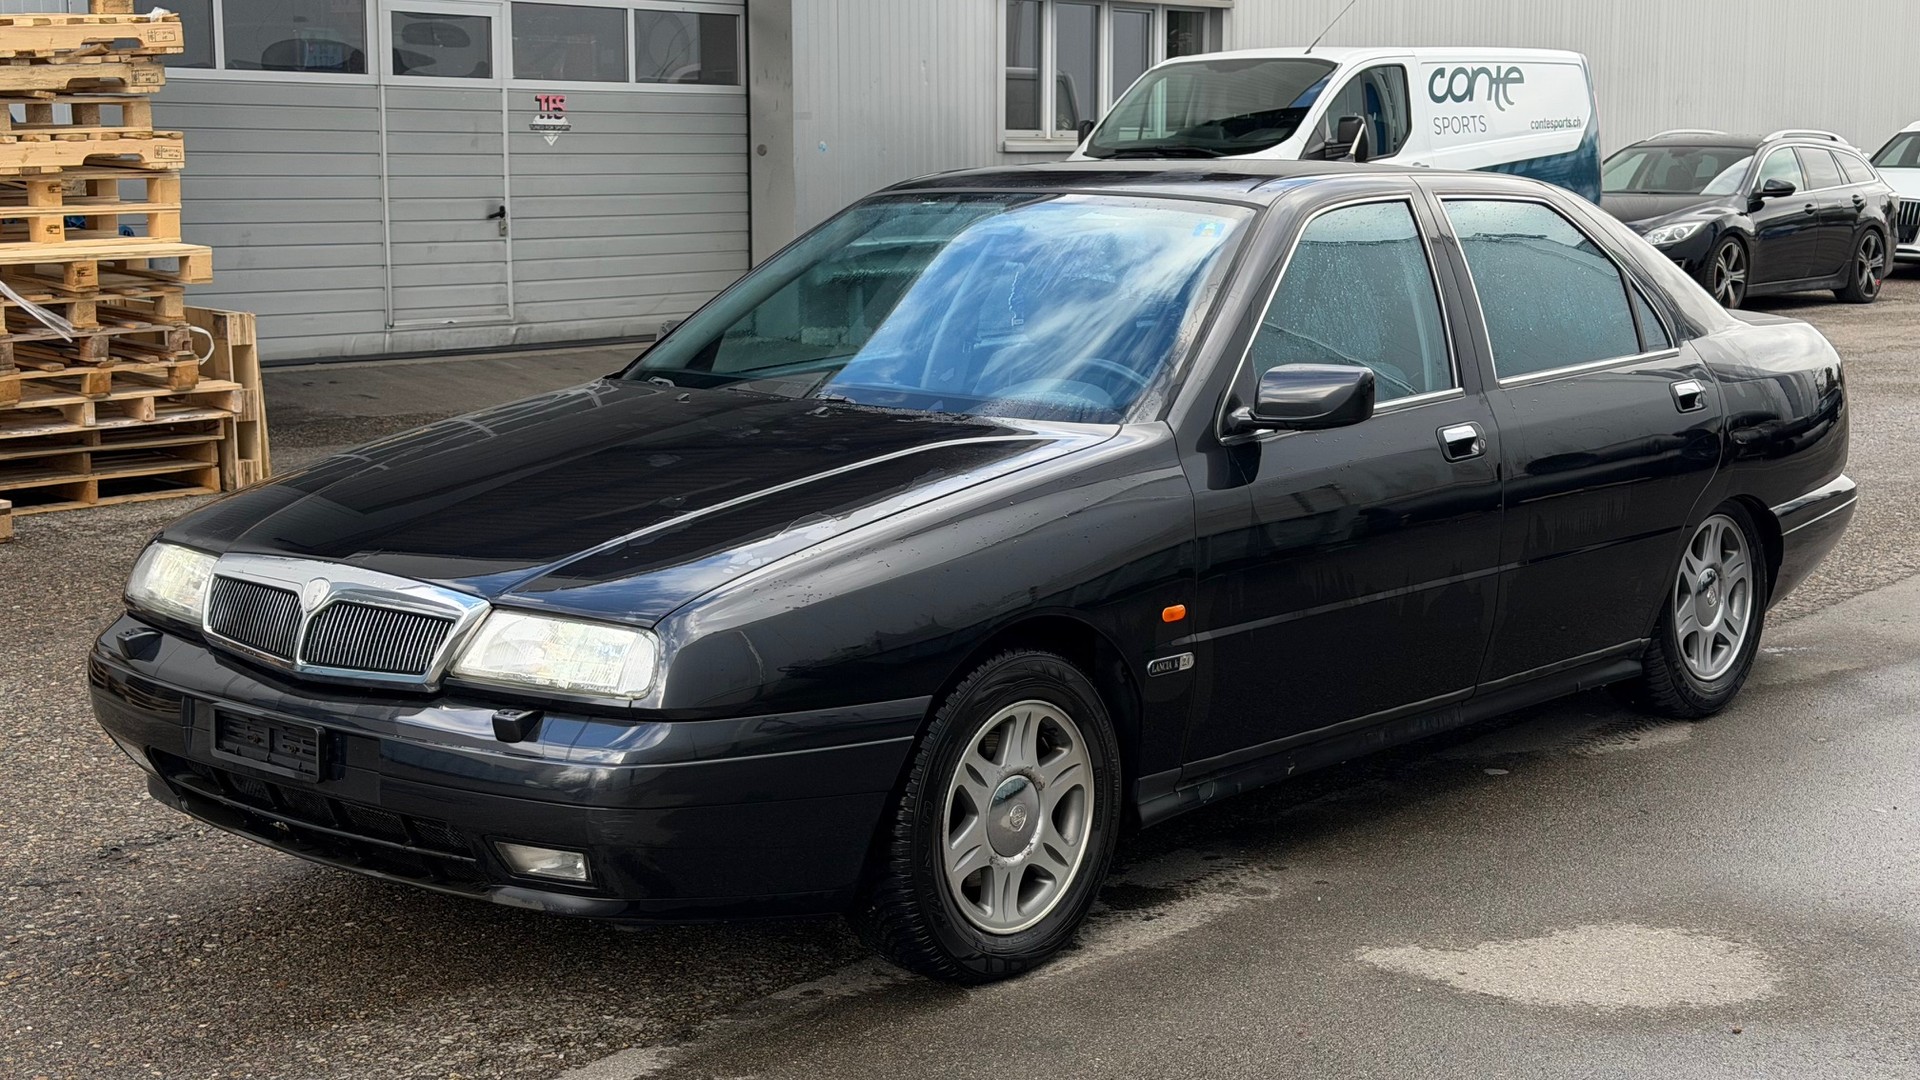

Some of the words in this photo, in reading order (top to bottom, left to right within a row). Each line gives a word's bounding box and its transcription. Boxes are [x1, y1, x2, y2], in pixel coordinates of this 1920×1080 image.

[1428, 65, 1525, 112] conte
[1433, 115, 1487, 135] SPORTS
[1530, 117, 1581, 131] contesports.ch
